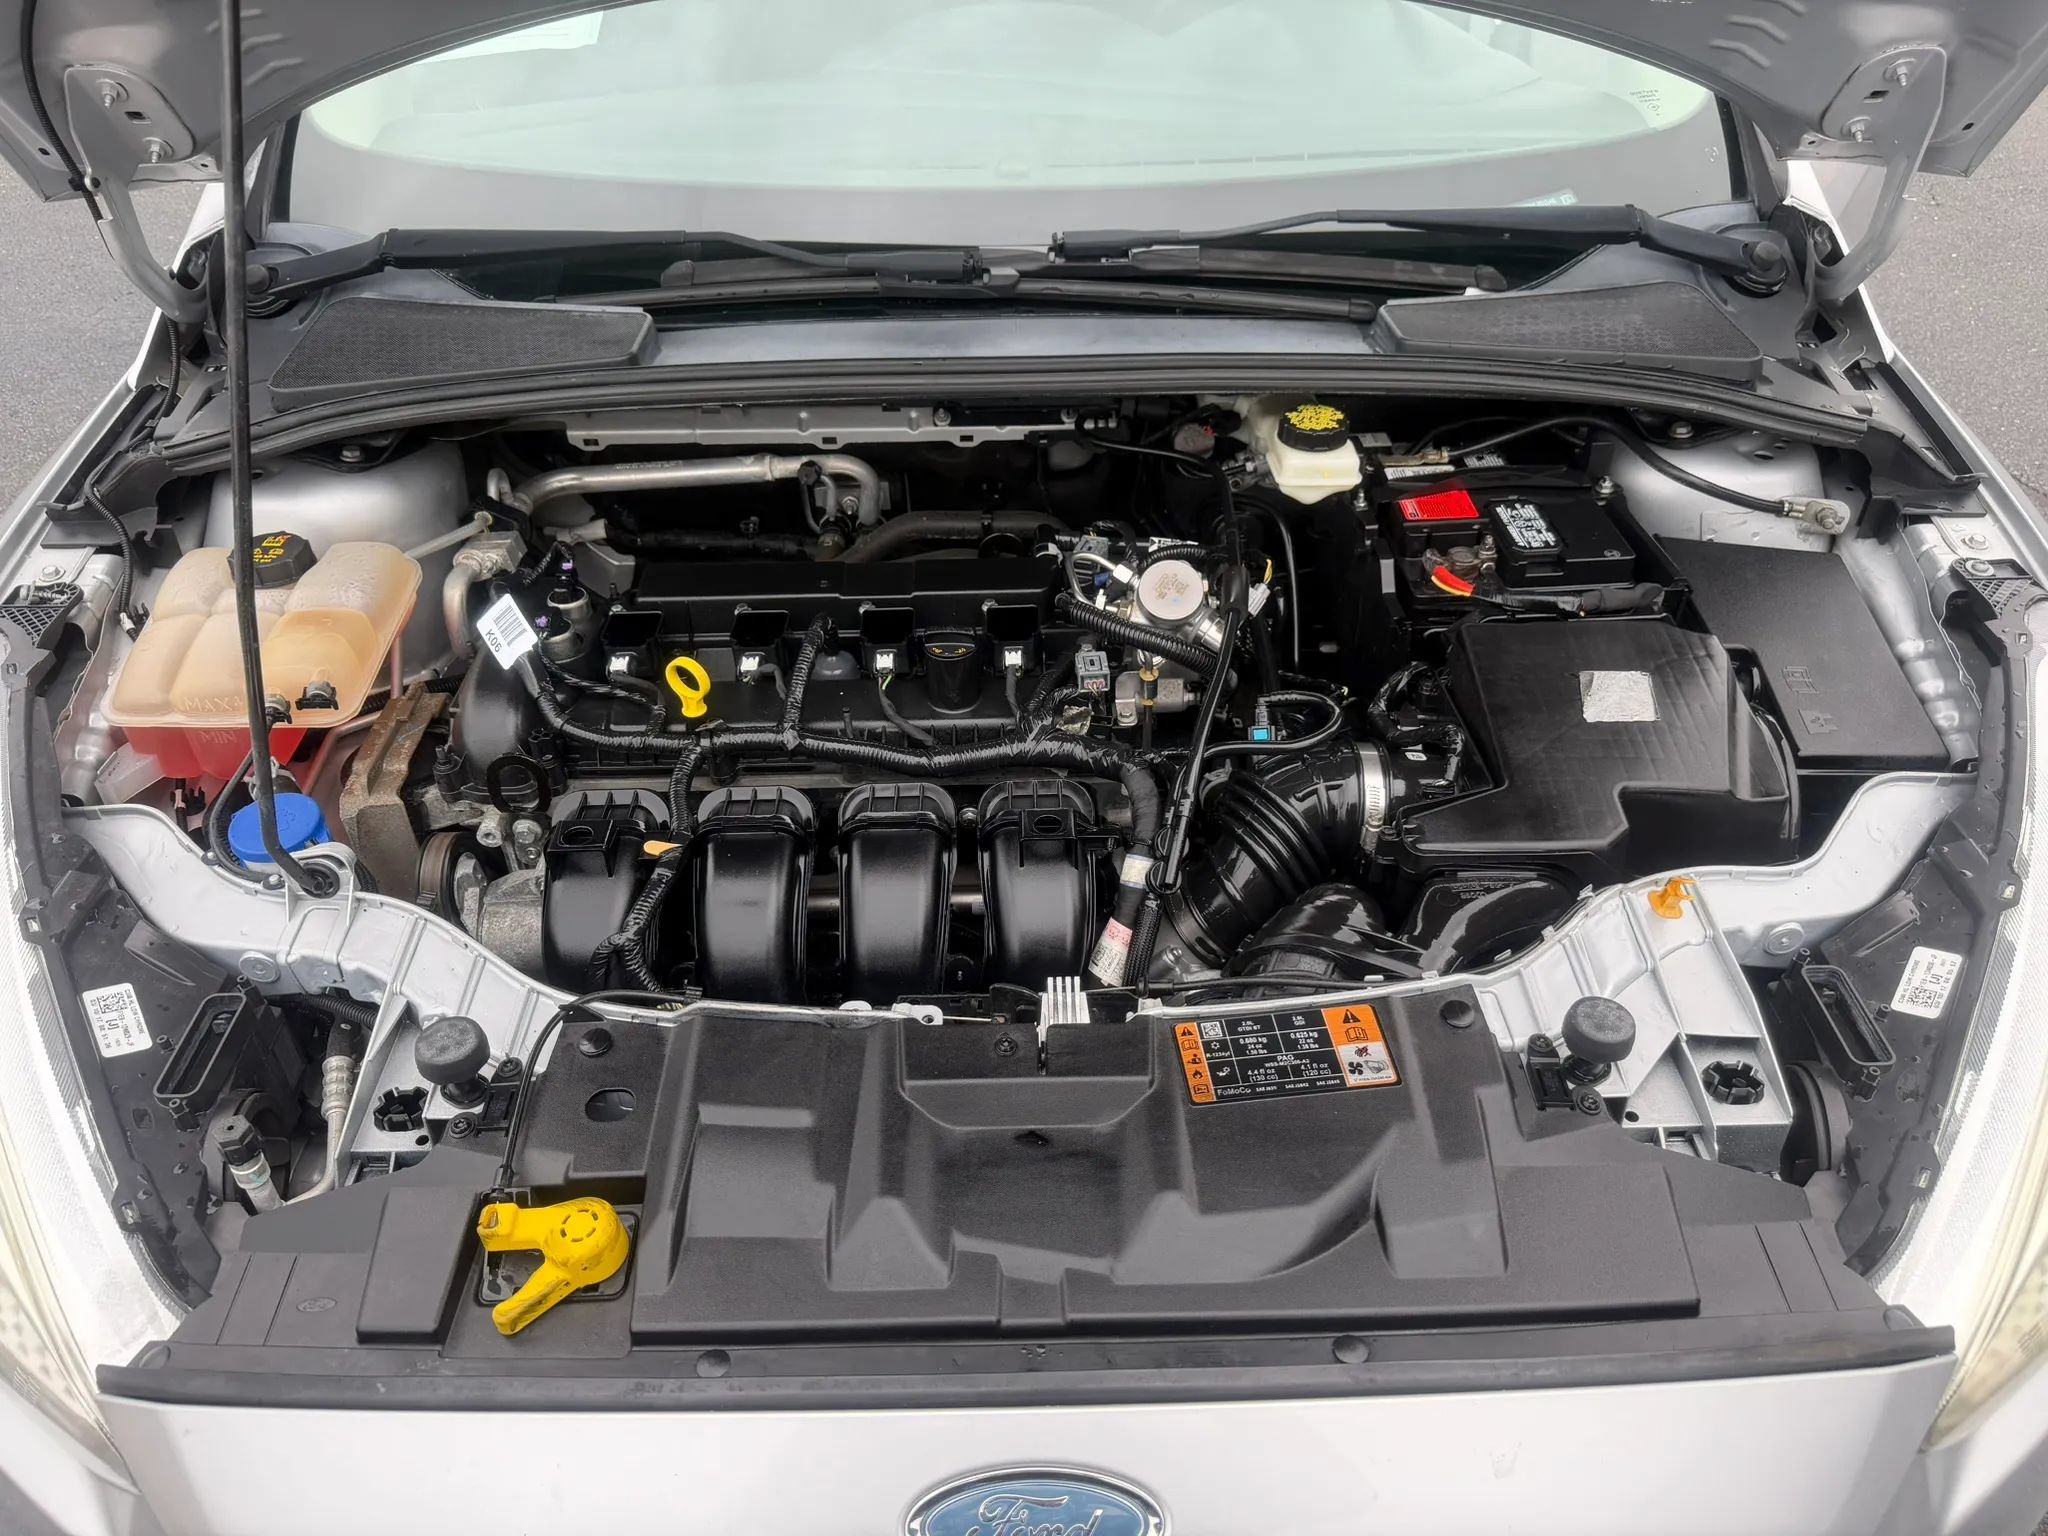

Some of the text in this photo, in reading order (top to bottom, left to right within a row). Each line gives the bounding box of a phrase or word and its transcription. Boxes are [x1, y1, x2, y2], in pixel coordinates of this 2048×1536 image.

[485, 628, 503, 653] K06
[183, 696, 232, 711] MAX
[199, 730, 237, 744] MIN
[1276, 1054, 1295, 1062] PAG
[1217, 1087, 1252, 1096] FoMoCo
